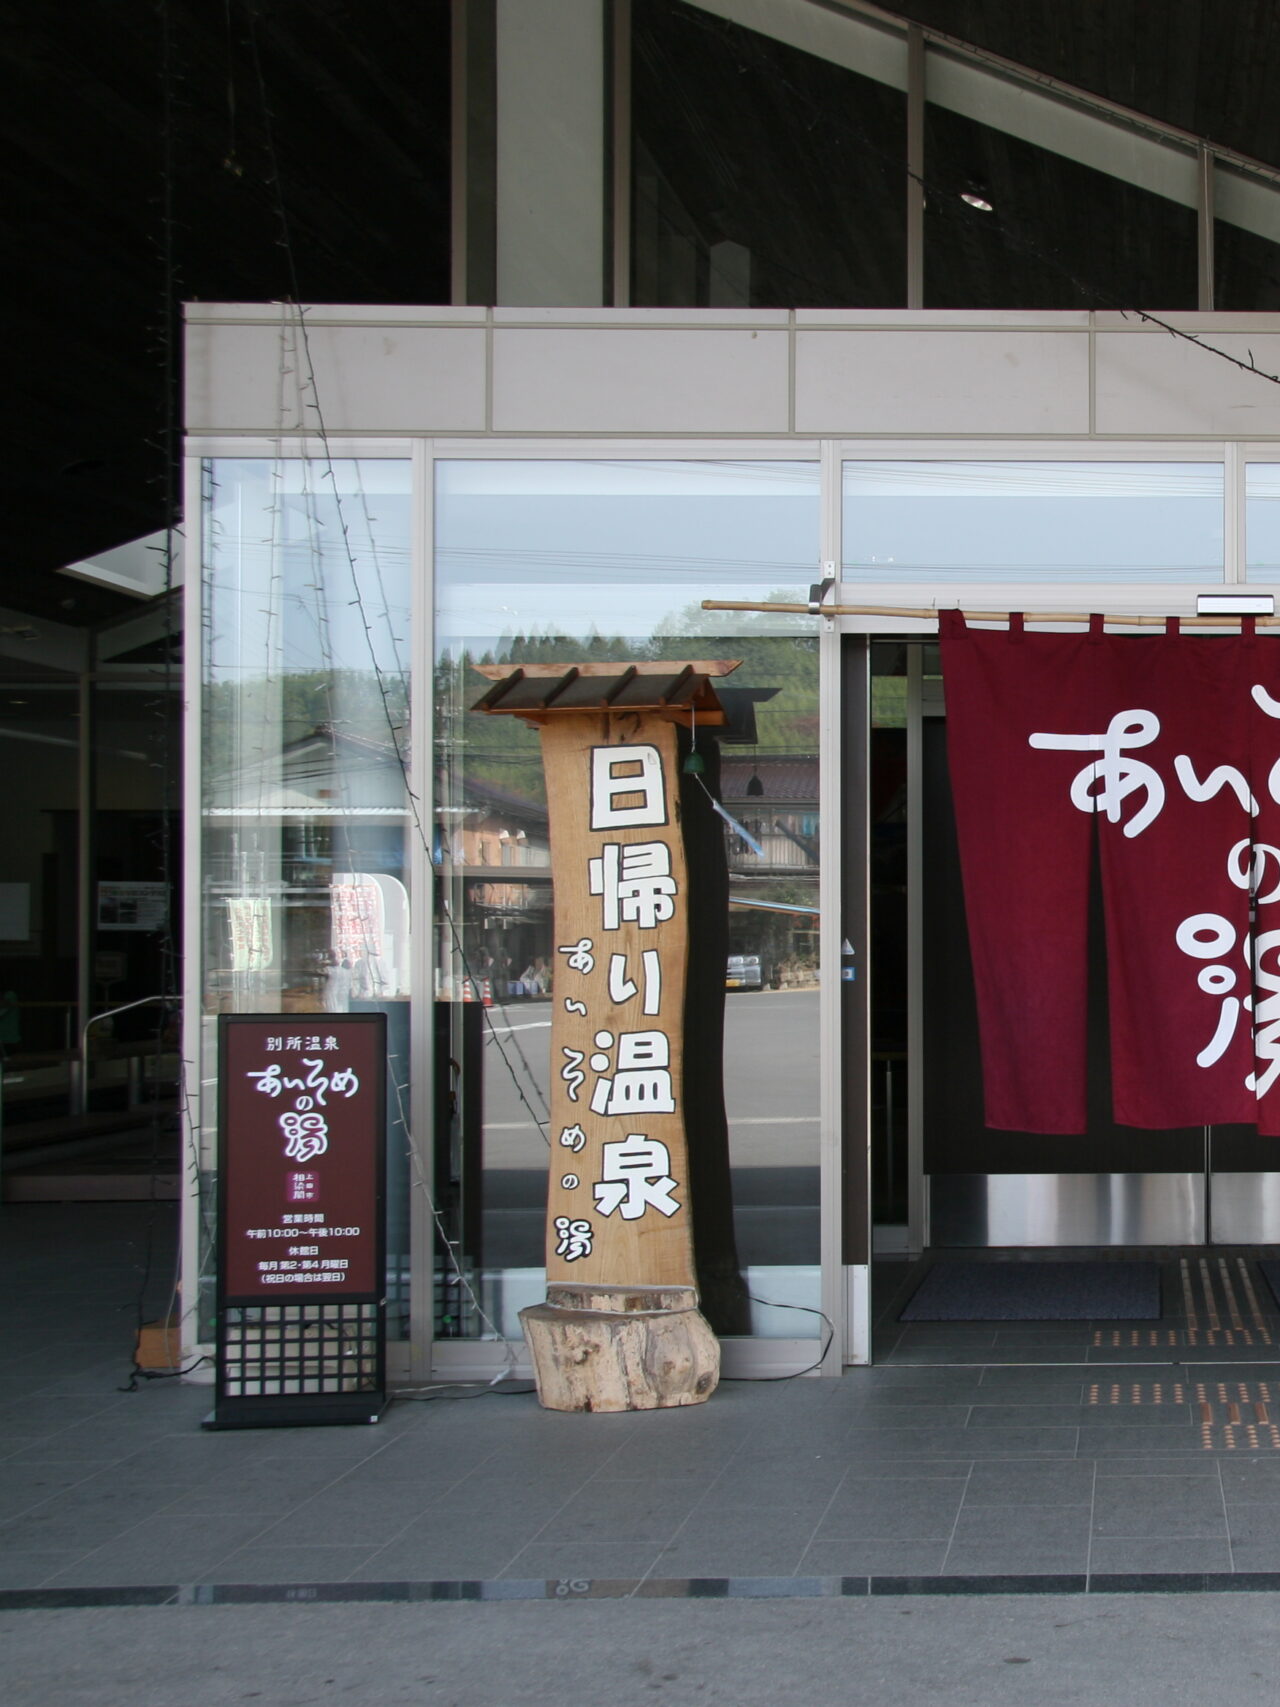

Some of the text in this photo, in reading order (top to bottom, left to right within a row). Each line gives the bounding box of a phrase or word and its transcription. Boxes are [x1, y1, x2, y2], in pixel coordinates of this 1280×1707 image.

[589, 744, 681, 1221] 日帰り温泉
[266, 1036, 339, 1051] 別所温泉
[553, 936, 596, 1262] あいそめの湯
[282, 1213, 325, 1224] 営業時間
[288, 1246, 319, 1256] 休館日
